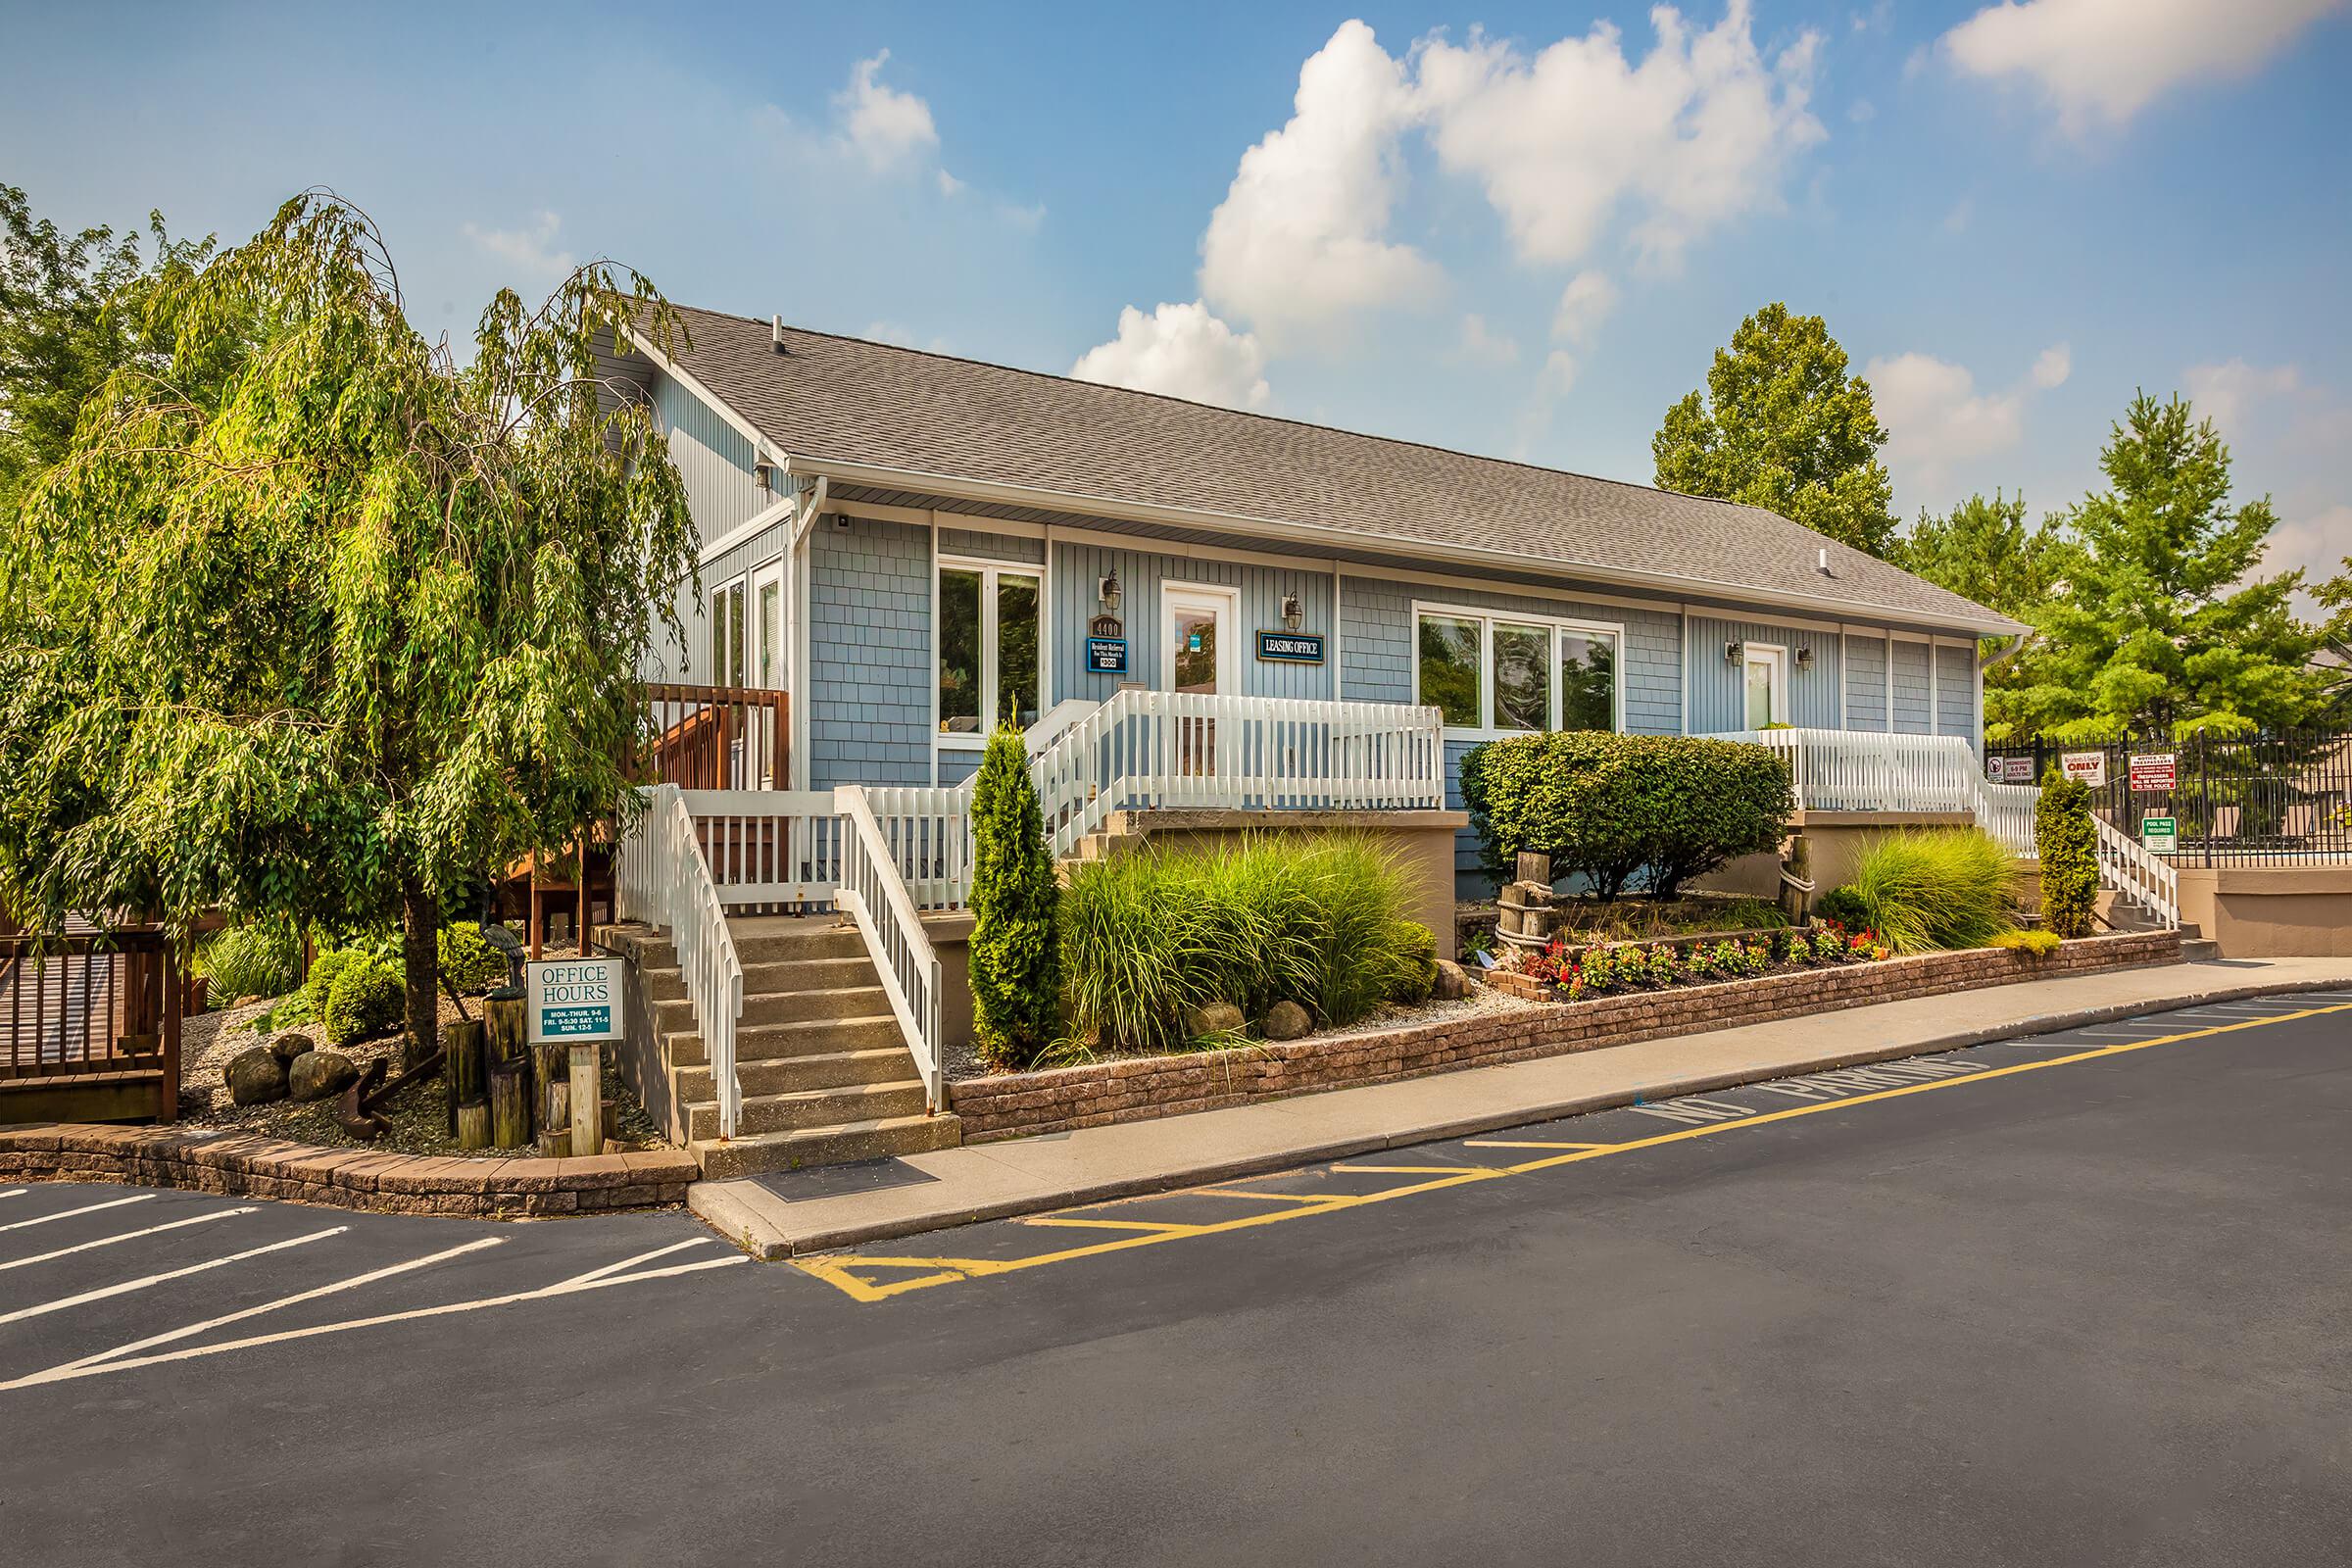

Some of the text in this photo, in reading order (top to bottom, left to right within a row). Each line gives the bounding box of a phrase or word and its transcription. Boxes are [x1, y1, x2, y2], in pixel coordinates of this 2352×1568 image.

[1098, 622, 1117, 635] 4400
[1265, 639, 1317, 655] LEASING OFFICE
[2068, 761, 2099, 771] ONLY
[542, 966, 608, 983] OFFICE
[543, 985, 608, 1002] HOURS
[1628, 1058, 1992, 1125] NO PARKING
